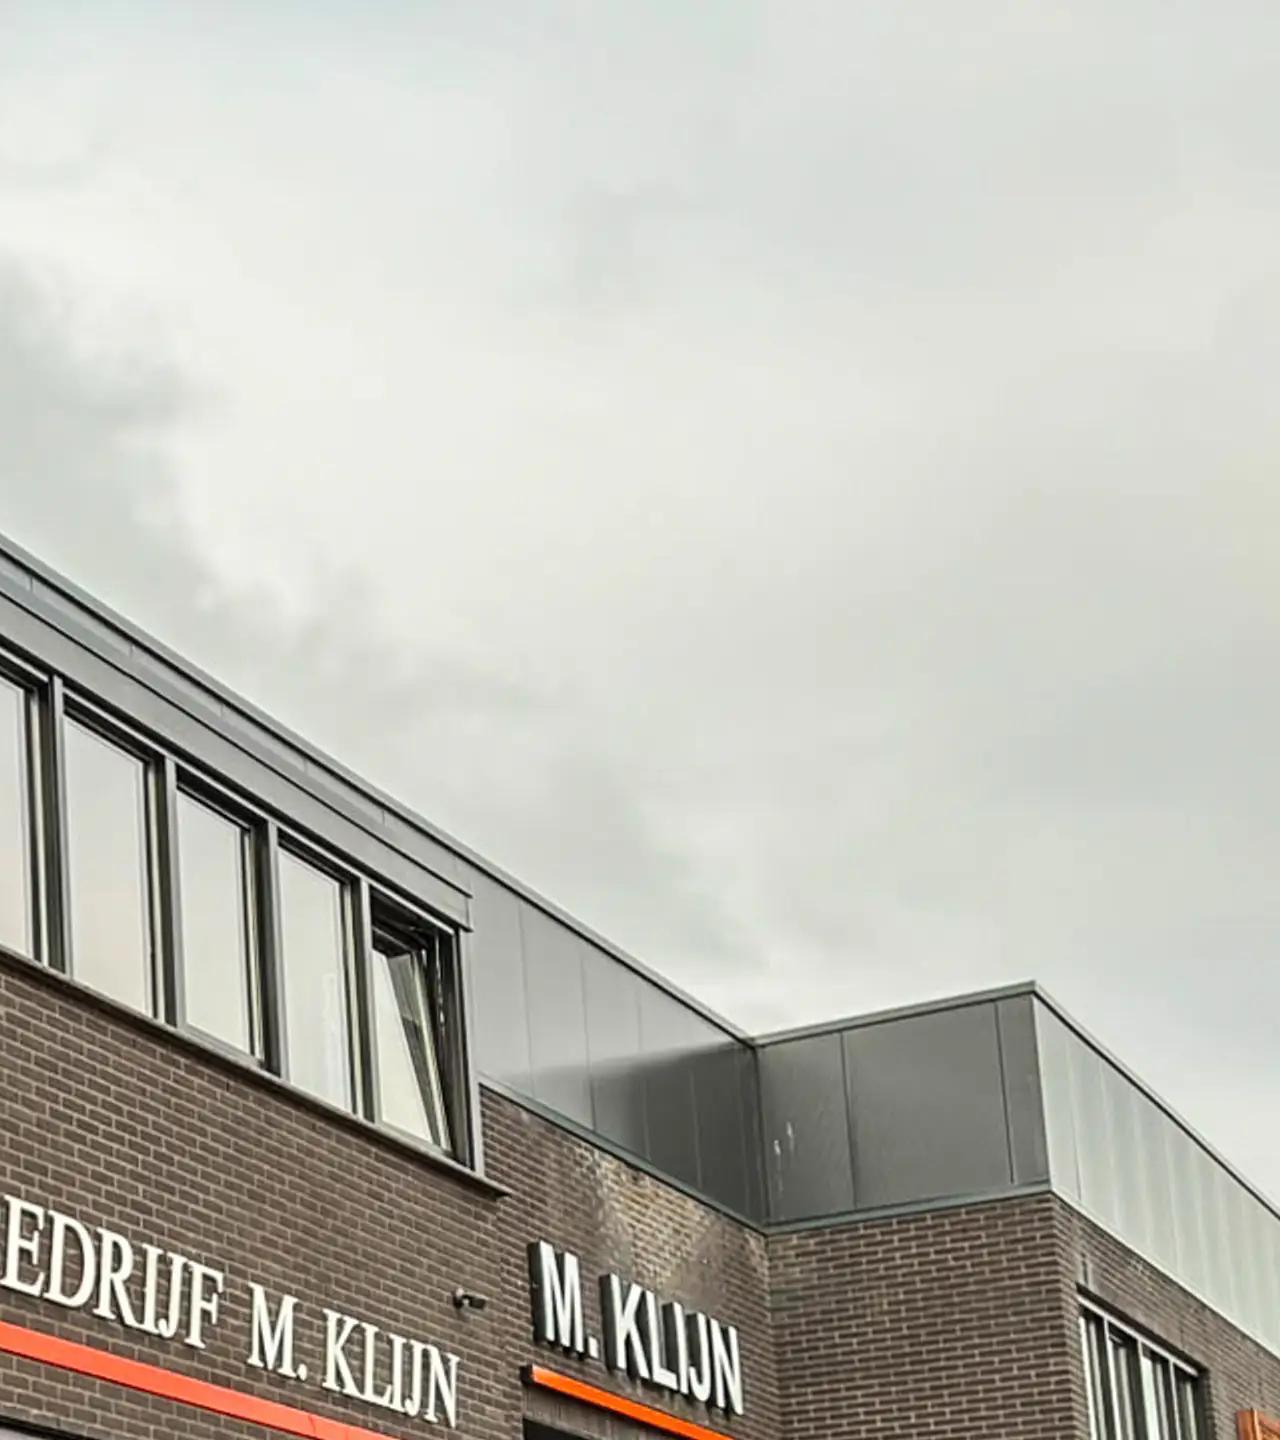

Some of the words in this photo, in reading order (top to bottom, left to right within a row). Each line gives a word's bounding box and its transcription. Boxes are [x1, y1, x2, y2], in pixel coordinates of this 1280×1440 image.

[247, 1283, 308, 1381] M.
[322, 1309, 461, 1428] KLIJN
[539, 1240, 599, 1358] M.
[610, 1274, 744, 1415] KLIJN
